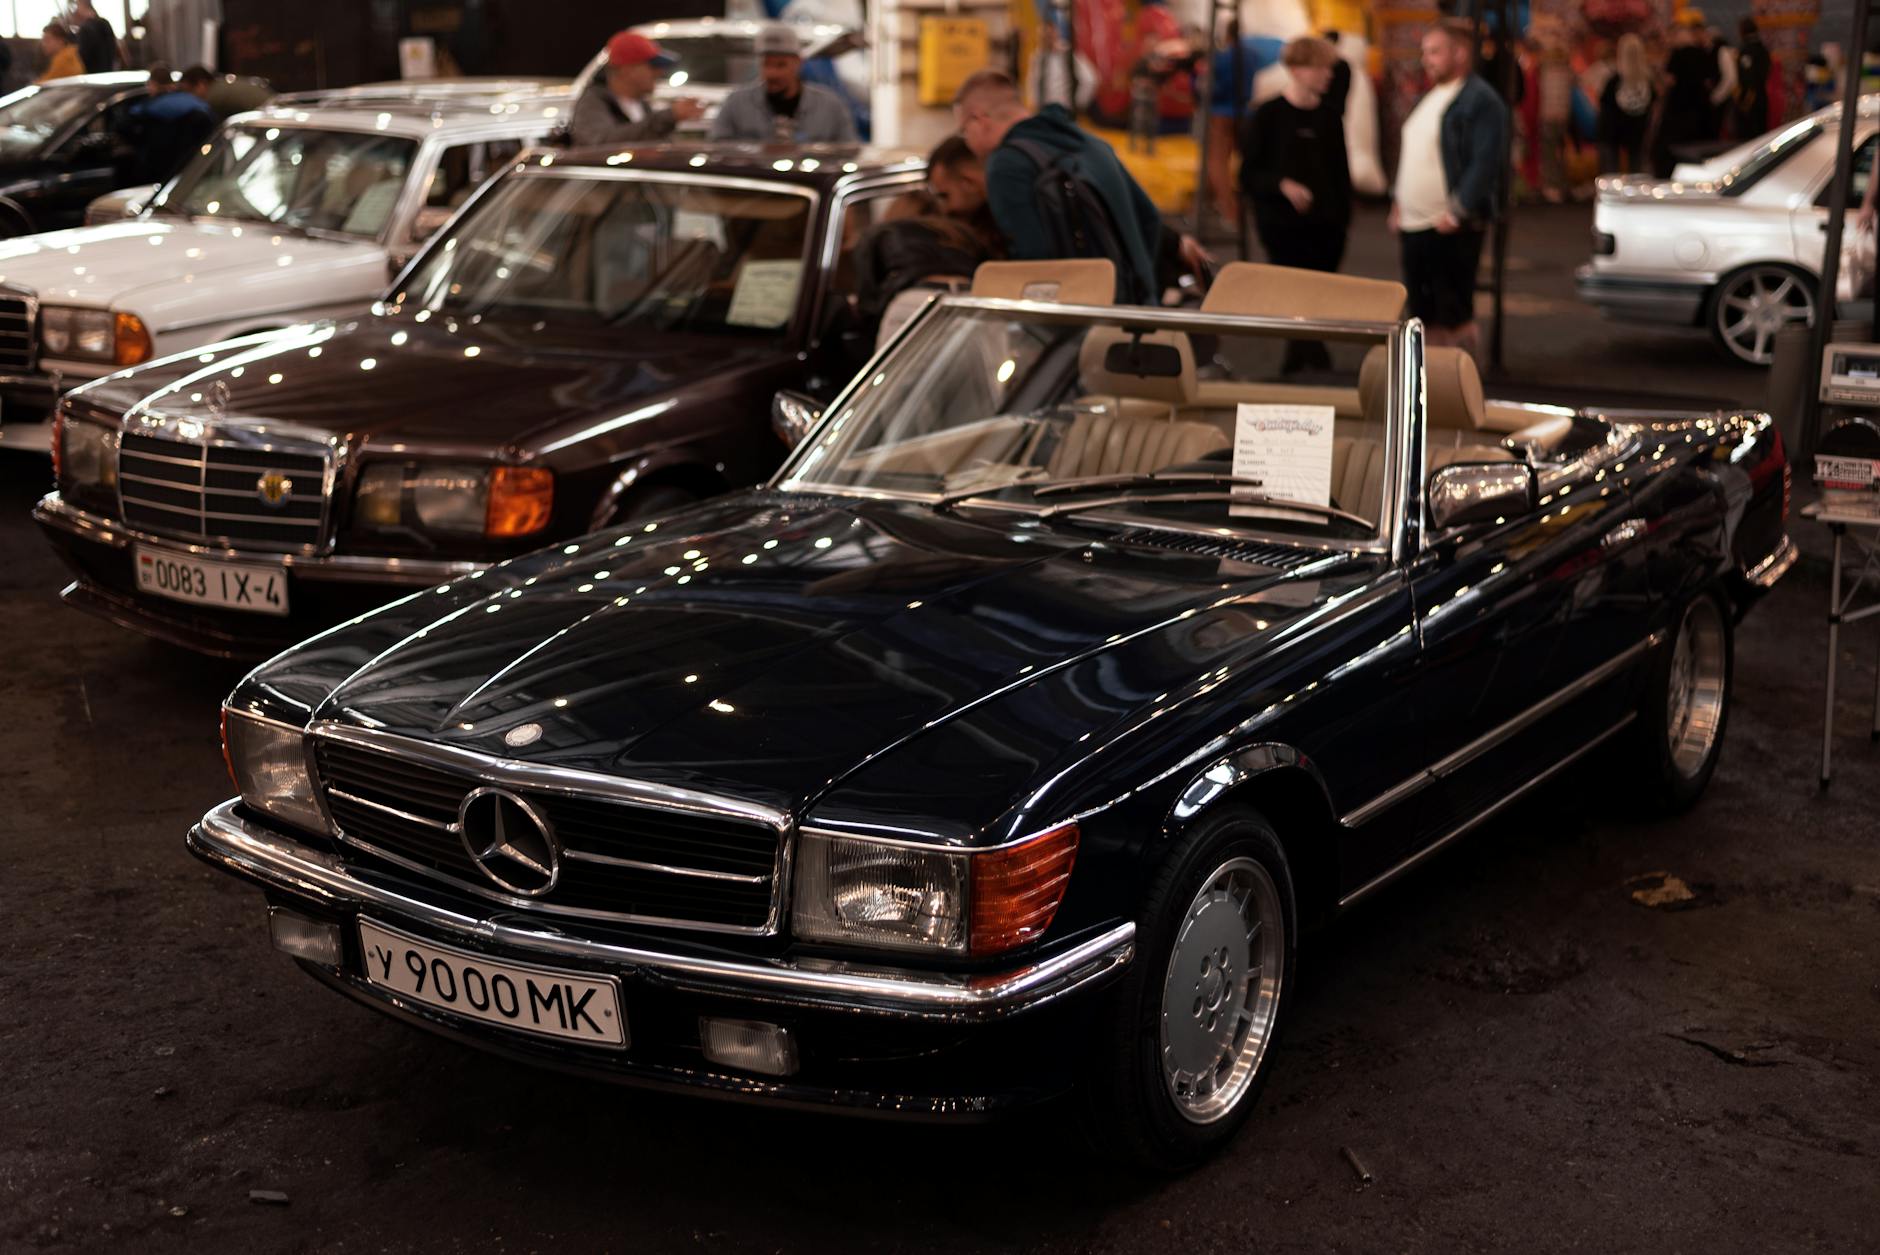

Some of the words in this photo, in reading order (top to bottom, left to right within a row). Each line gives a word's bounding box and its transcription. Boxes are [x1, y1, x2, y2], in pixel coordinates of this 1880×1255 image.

[156, 559, 206, 596] 0083
[221, 571, 280, 606] IX-4
[405, 950, 520, 1019] 9000
